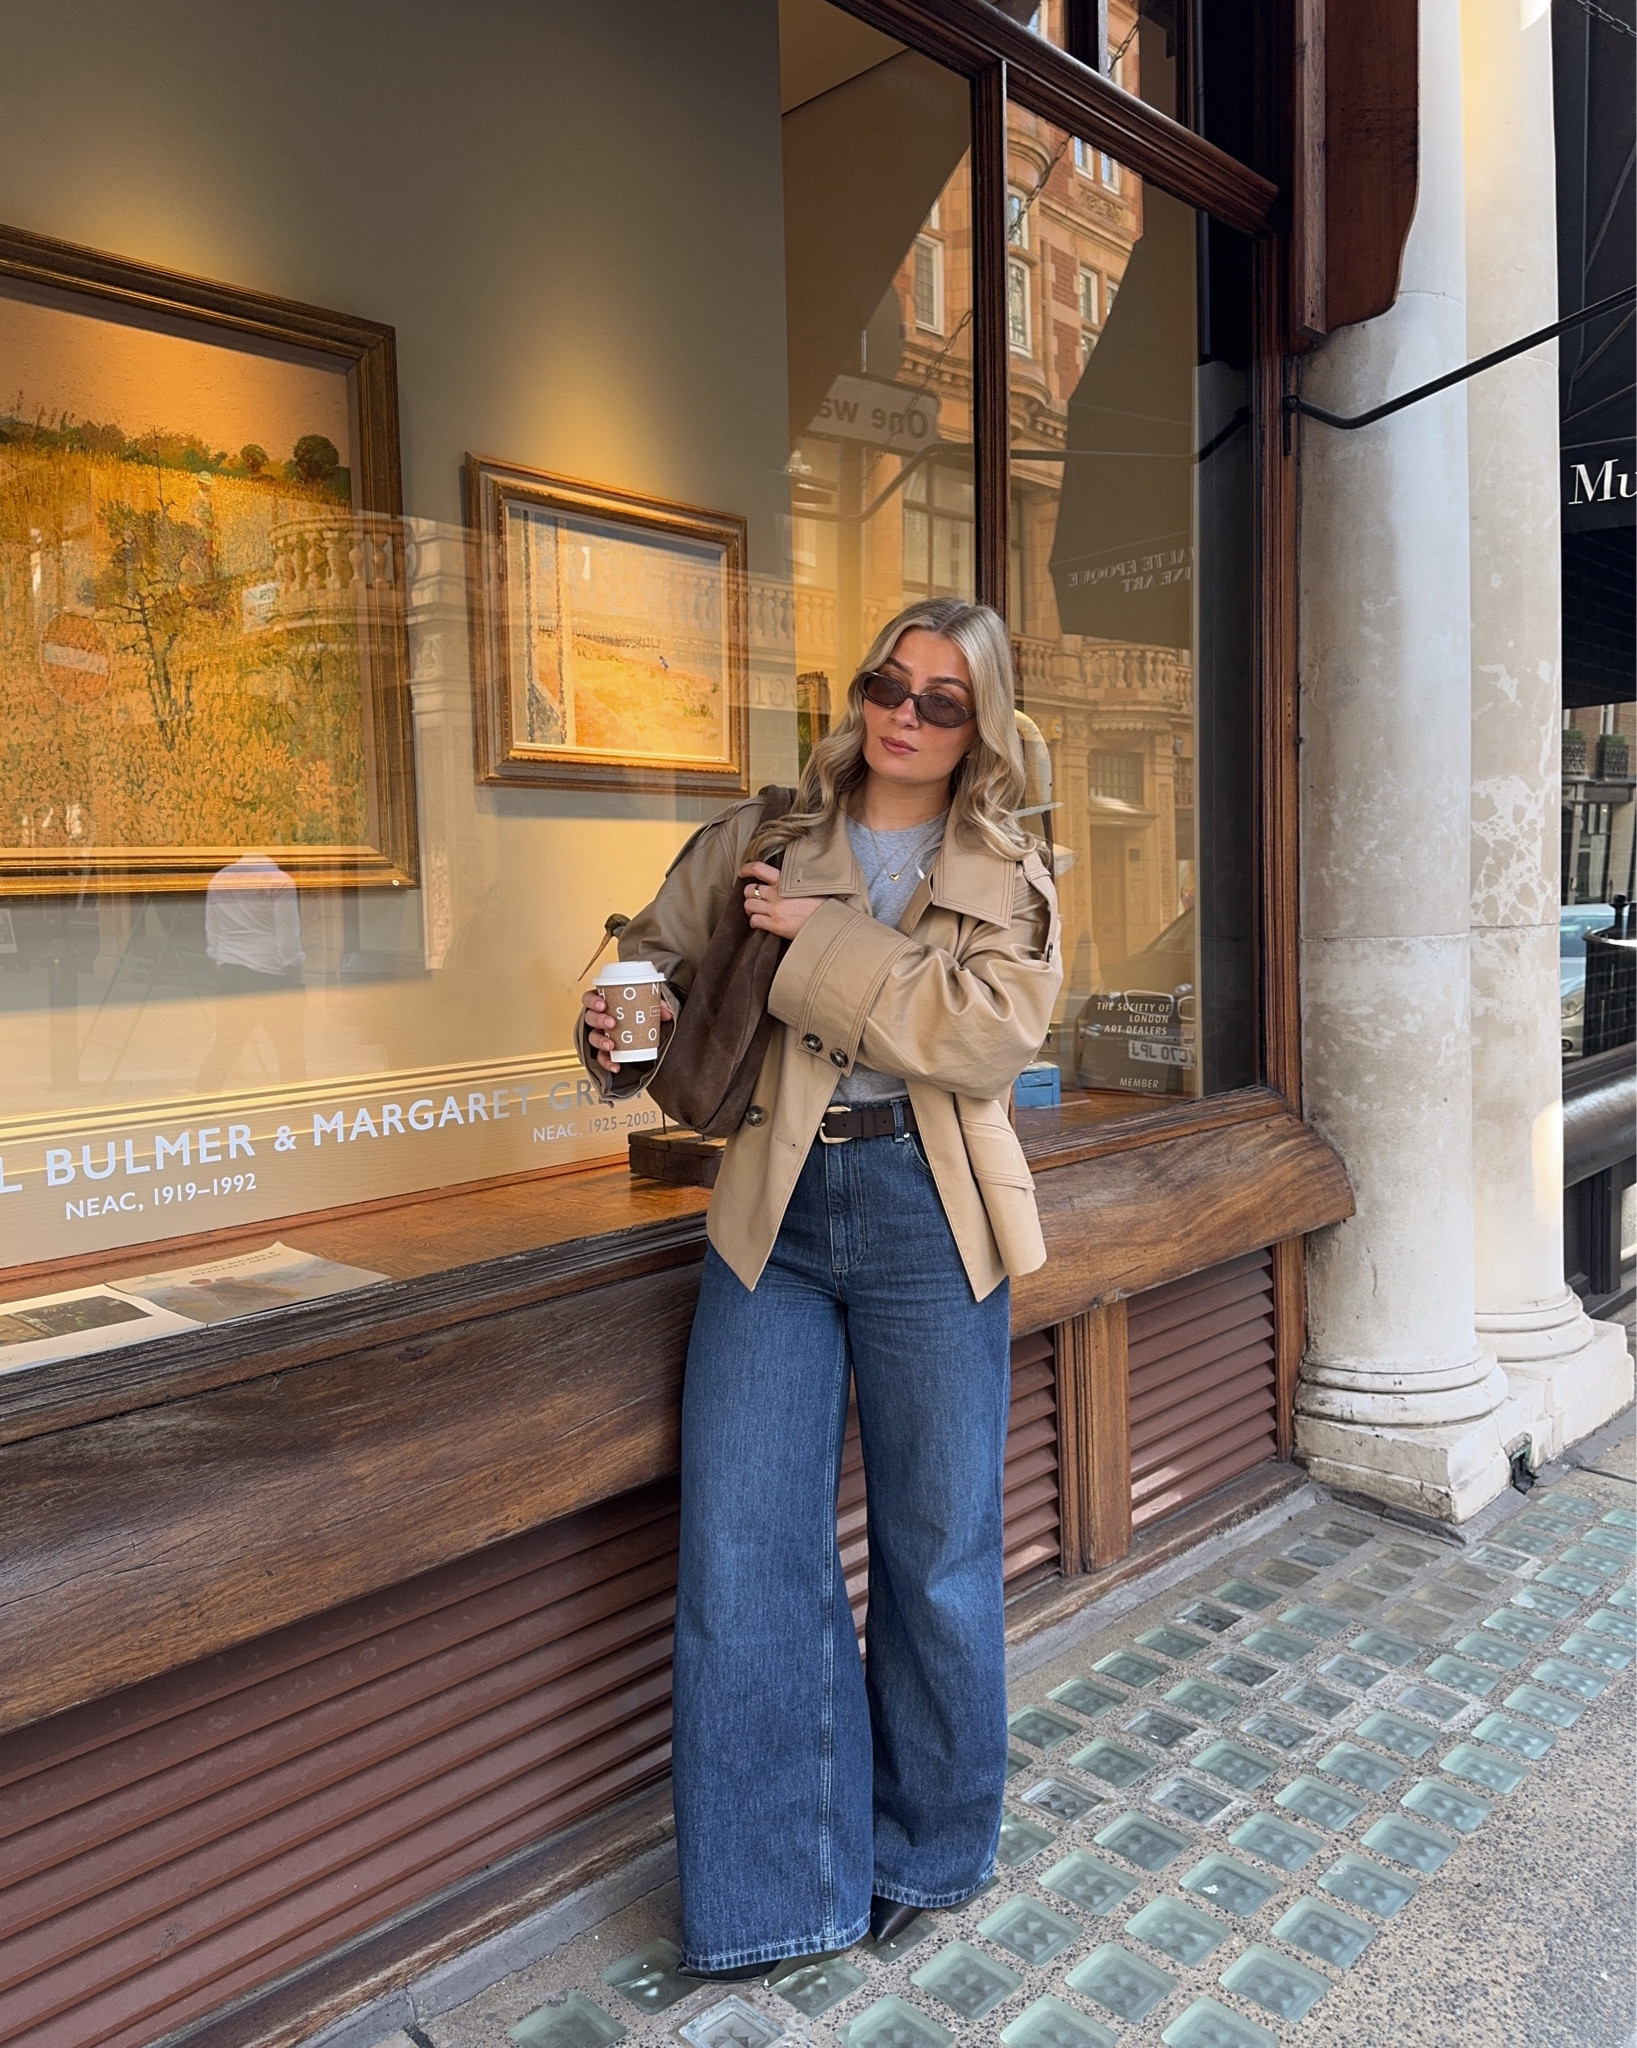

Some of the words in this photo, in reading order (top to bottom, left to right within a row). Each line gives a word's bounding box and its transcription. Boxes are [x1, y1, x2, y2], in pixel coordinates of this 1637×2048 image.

[1568, 458, 1637, 505] Mu
[1097, 1002, 1114, 1012] THE
[1117, 1003, 1157, 1013] SOCIETY
[1158, 1004, 1171, 1013] OF
[1103, 1024, 1123, 1034] ART
[1125, 1025, 1168, 1036] DEALERS
[1129, 1014, 1169, 1024] LONDON
[1119, 1077, 1160, 1089] MEMBER
[46, 1124, 256, 1186] BULMER
[274, 1125, 297, 1151] &
[313, 1087, 534, 1146] MARGARET
[533, 1122, 583, 1142] NEAC,
[589, 1110, 657, 1133] 1925–2003
[65, 1192, 144, 1221] NEAC,
[153, 1172, 257, 1206] 1919–1992
